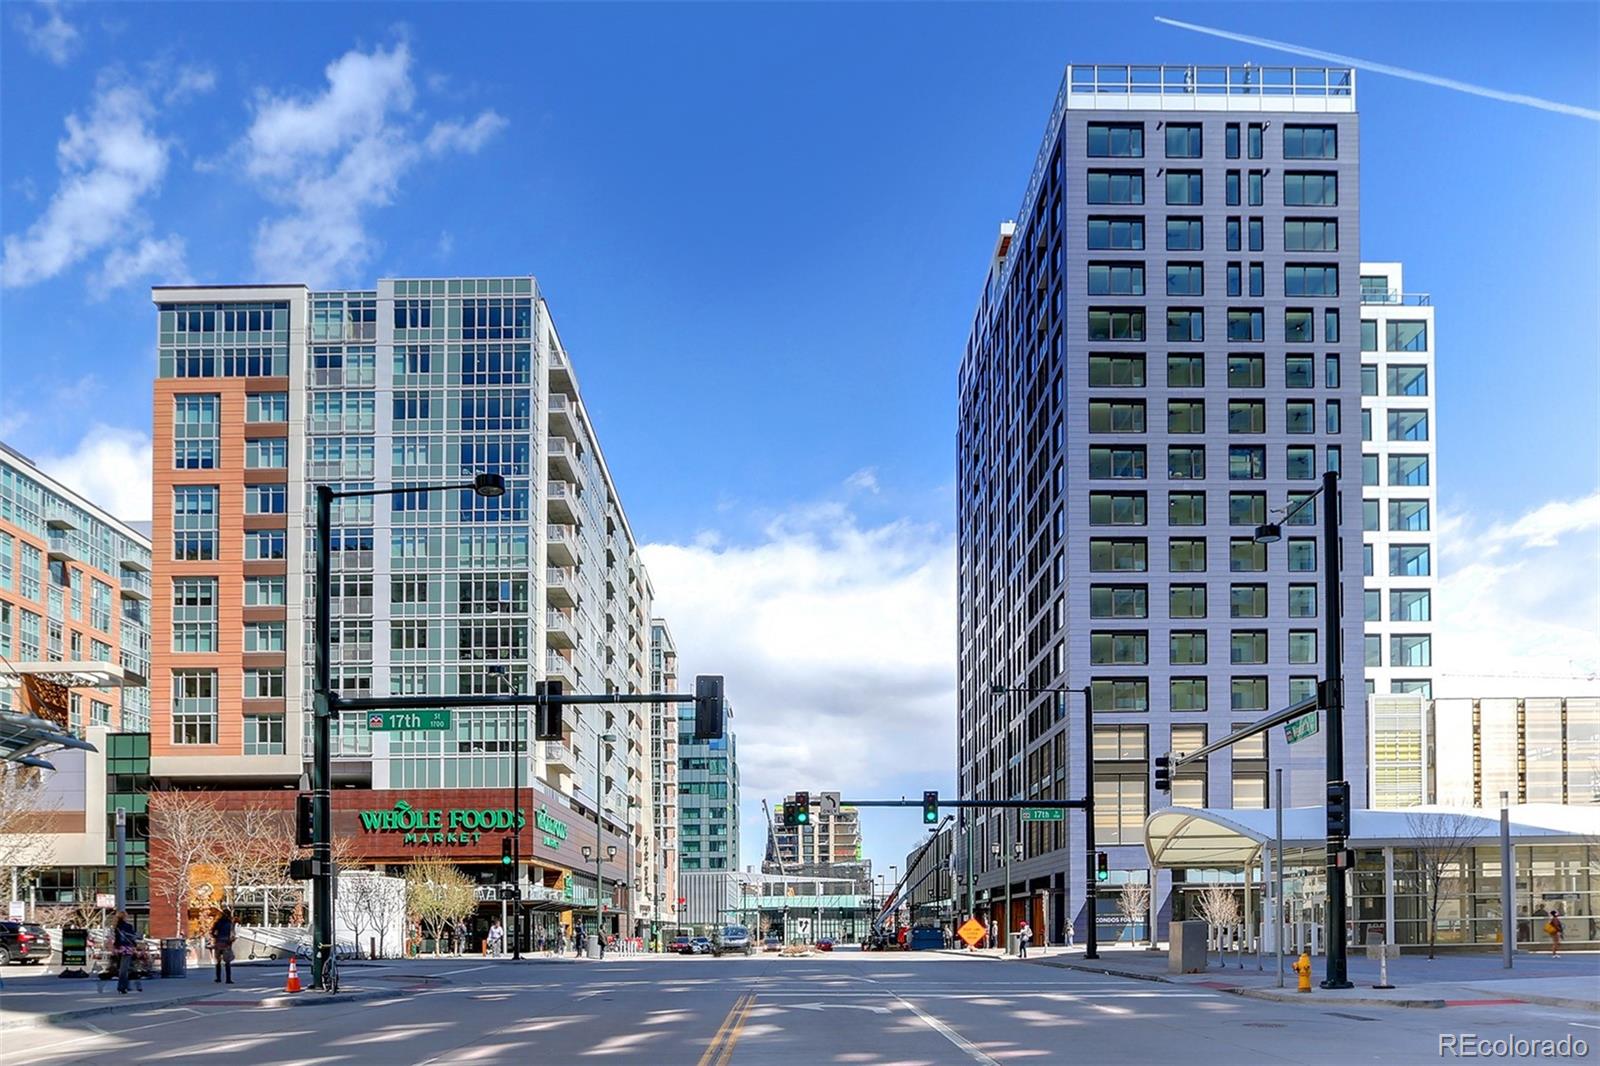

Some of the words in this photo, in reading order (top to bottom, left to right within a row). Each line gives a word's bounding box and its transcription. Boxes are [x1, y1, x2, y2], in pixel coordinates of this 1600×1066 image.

[389, 713, 421, 728] 17th
[358, 806, 442, 830] WHOLE
[449, 808, 526, 830] FOODS
[1034, 810, 1050, 819] 17th
[404, 831, 482, 843] MARKET
